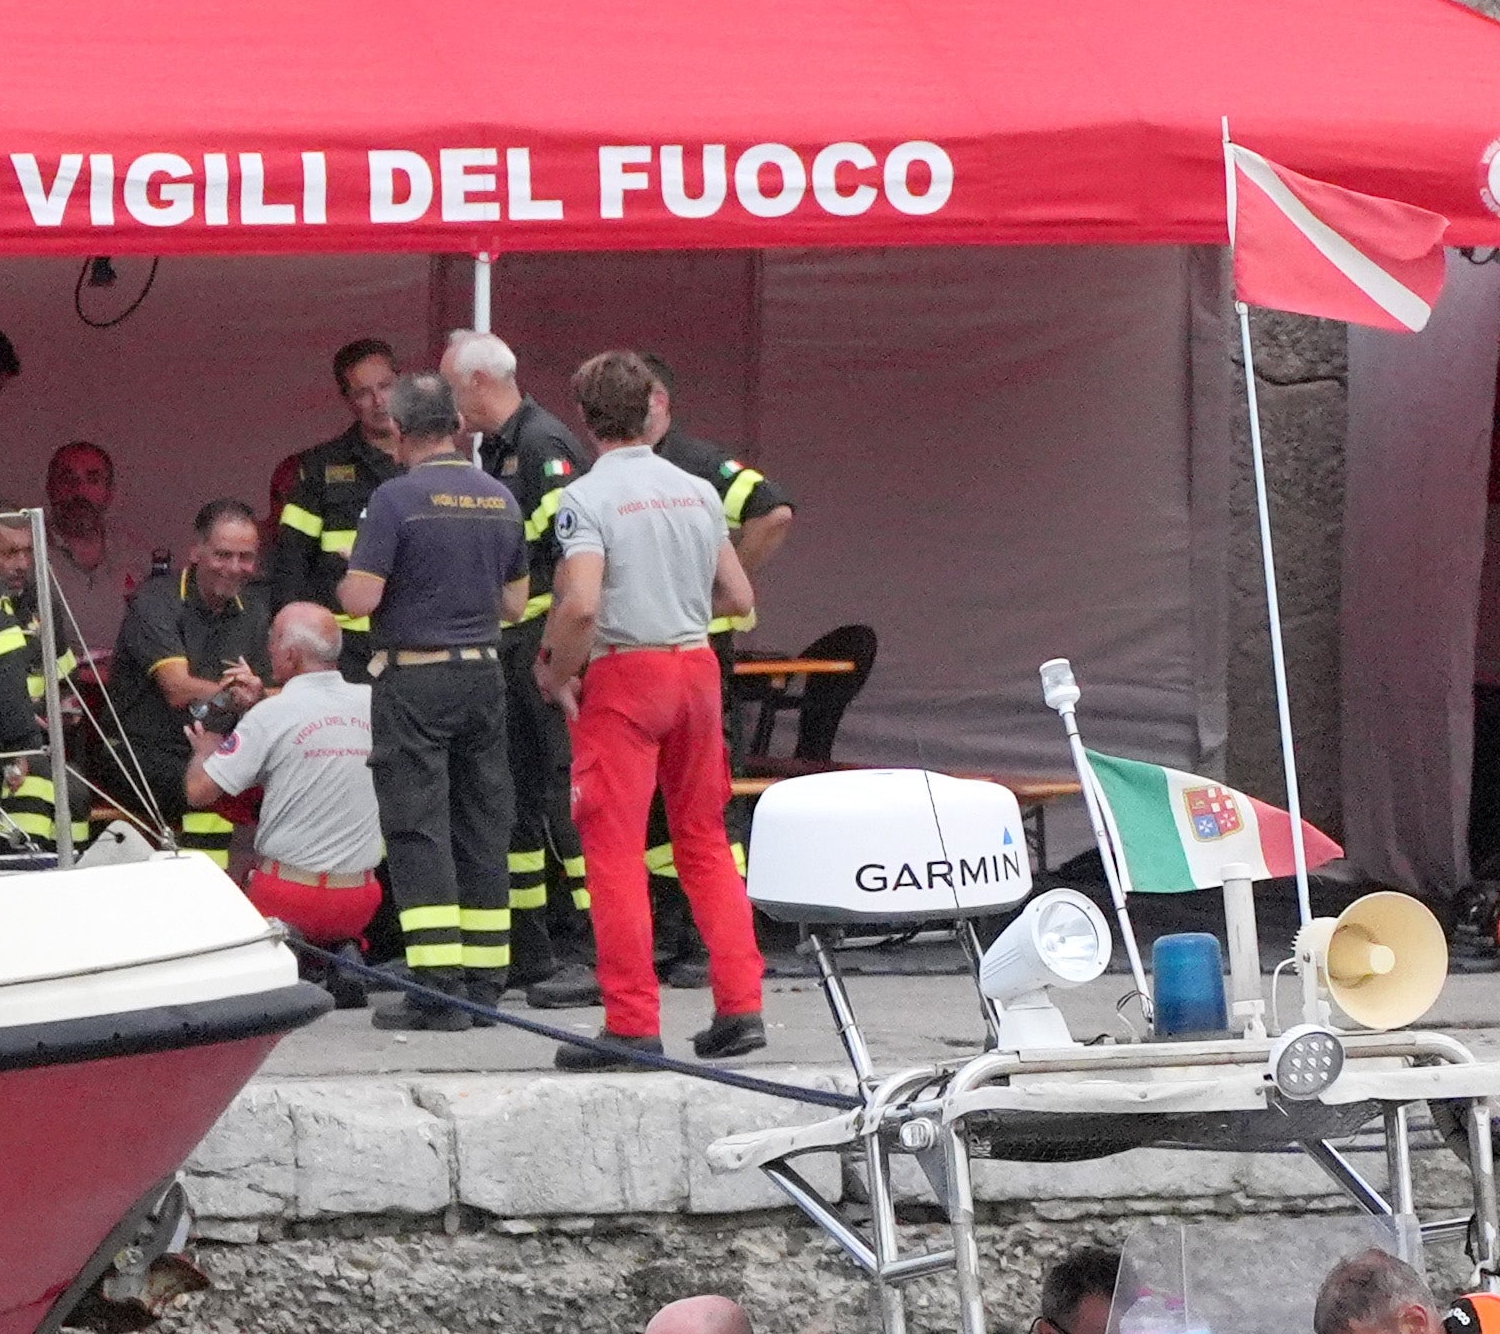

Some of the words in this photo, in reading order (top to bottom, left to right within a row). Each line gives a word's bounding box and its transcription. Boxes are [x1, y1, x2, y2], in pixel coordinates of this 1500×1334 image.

[11, 152, 326, 226] VIGILI
[368, 148, 563, 223] DEL
[599, 141, 953, 218] FUOCO
[855, 853, 1020, 893] GARMIN
